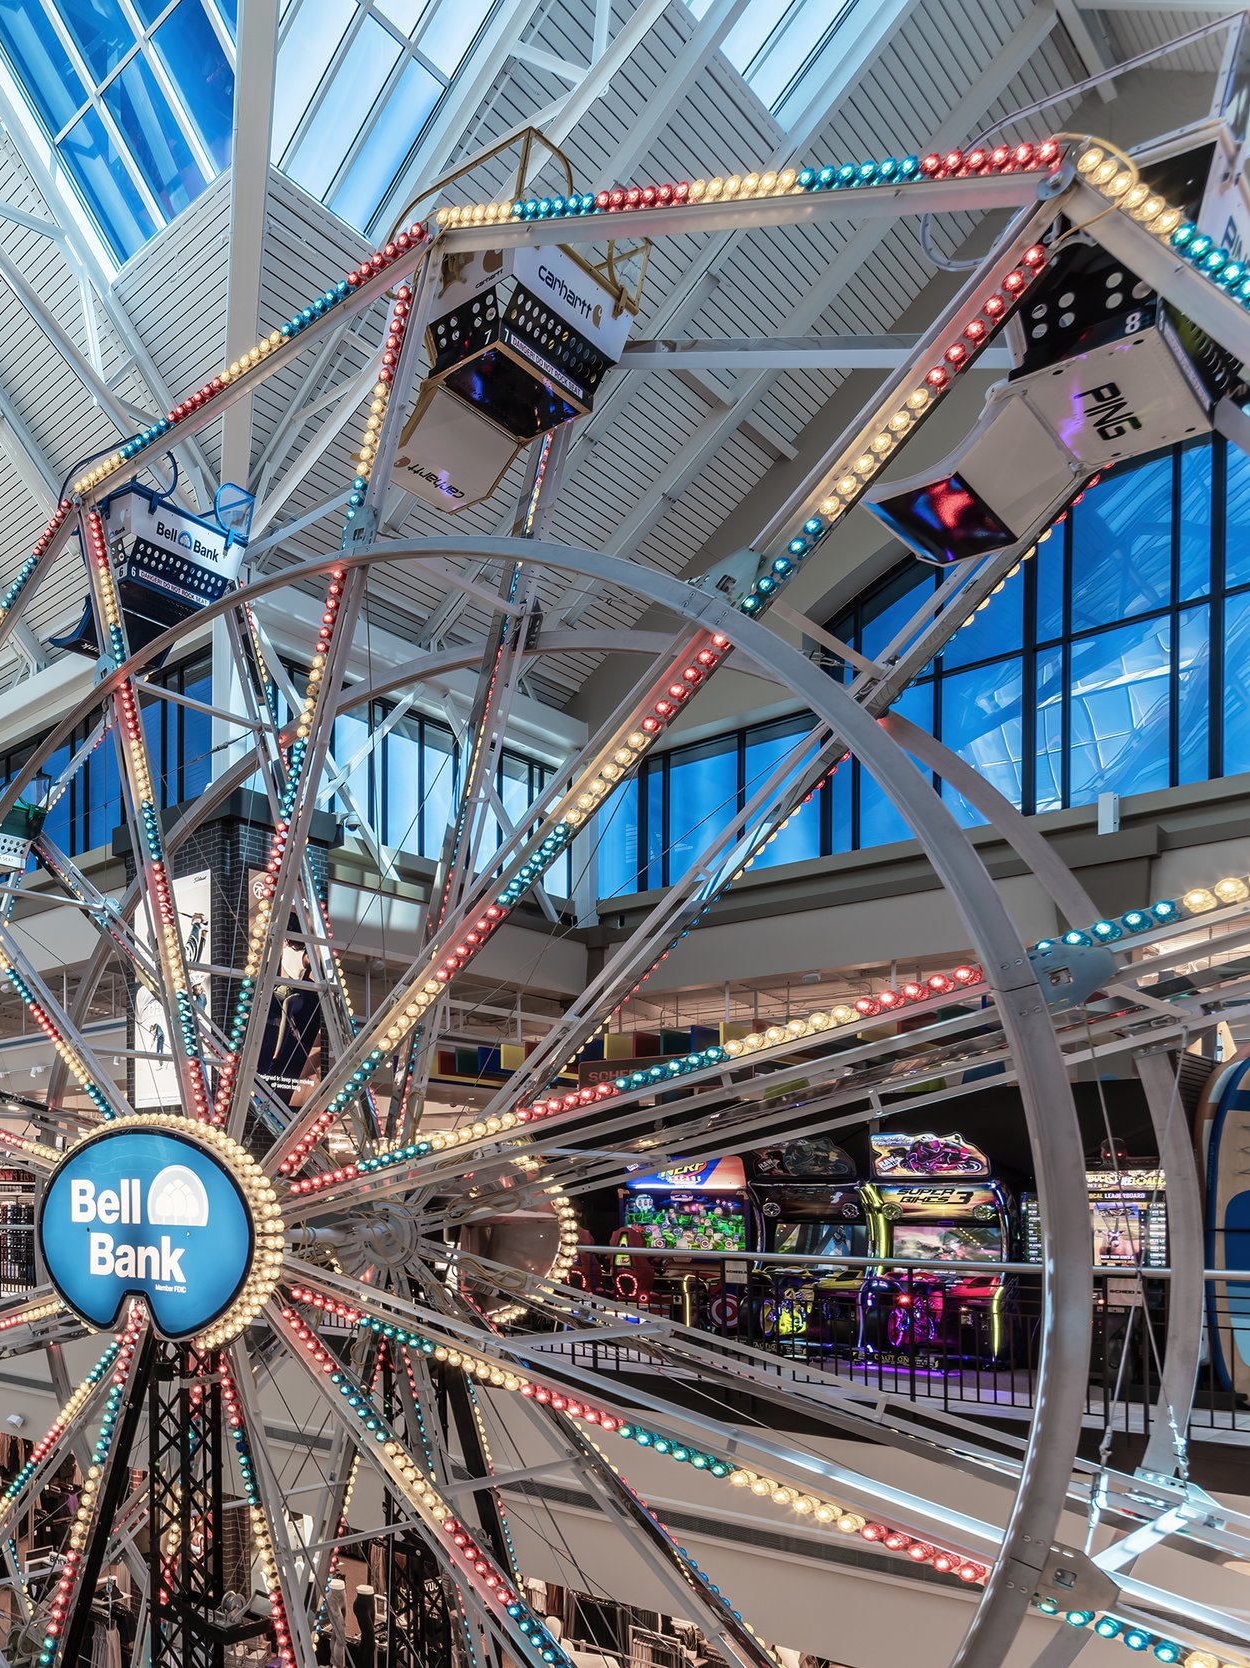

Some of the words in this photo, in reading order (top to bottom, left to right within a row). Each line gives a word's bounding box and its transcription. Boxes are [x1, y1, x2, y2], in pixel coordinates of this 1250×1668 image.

[538, 264, 593, 319] carhartt
[1124, 312, 1141, 335] 8
[483, 328, 493, 346] 7
[504, 328, 510, 343] 7
[512, 337, 536, 362] DANGER!
[535, 356, 544, 367] DO
[543, 362, 554, 375] NOT
[553, 369, 569, 388] ROCK
[568, 381, 582, 397] SEAT
[1073, 382, 1143, 441] PING
[407, 463, 465, 499] carhartt
[156, 521, 178, 543] Bell
[193, 539, 219, 562] Bank
[118, 567, 124, 577] 6
[131, 566, 136, 577] 6
[71, 1178, 141, 1225] Bell
[897, 1188, 956, 1196] SUPER
[900, 1196, 950, 1204] BIKES
[954, 1191, 974, 1205] 3
[90, 1231, 187, 1283] Bank
[174, 1285, 187, 1294] FDIC
